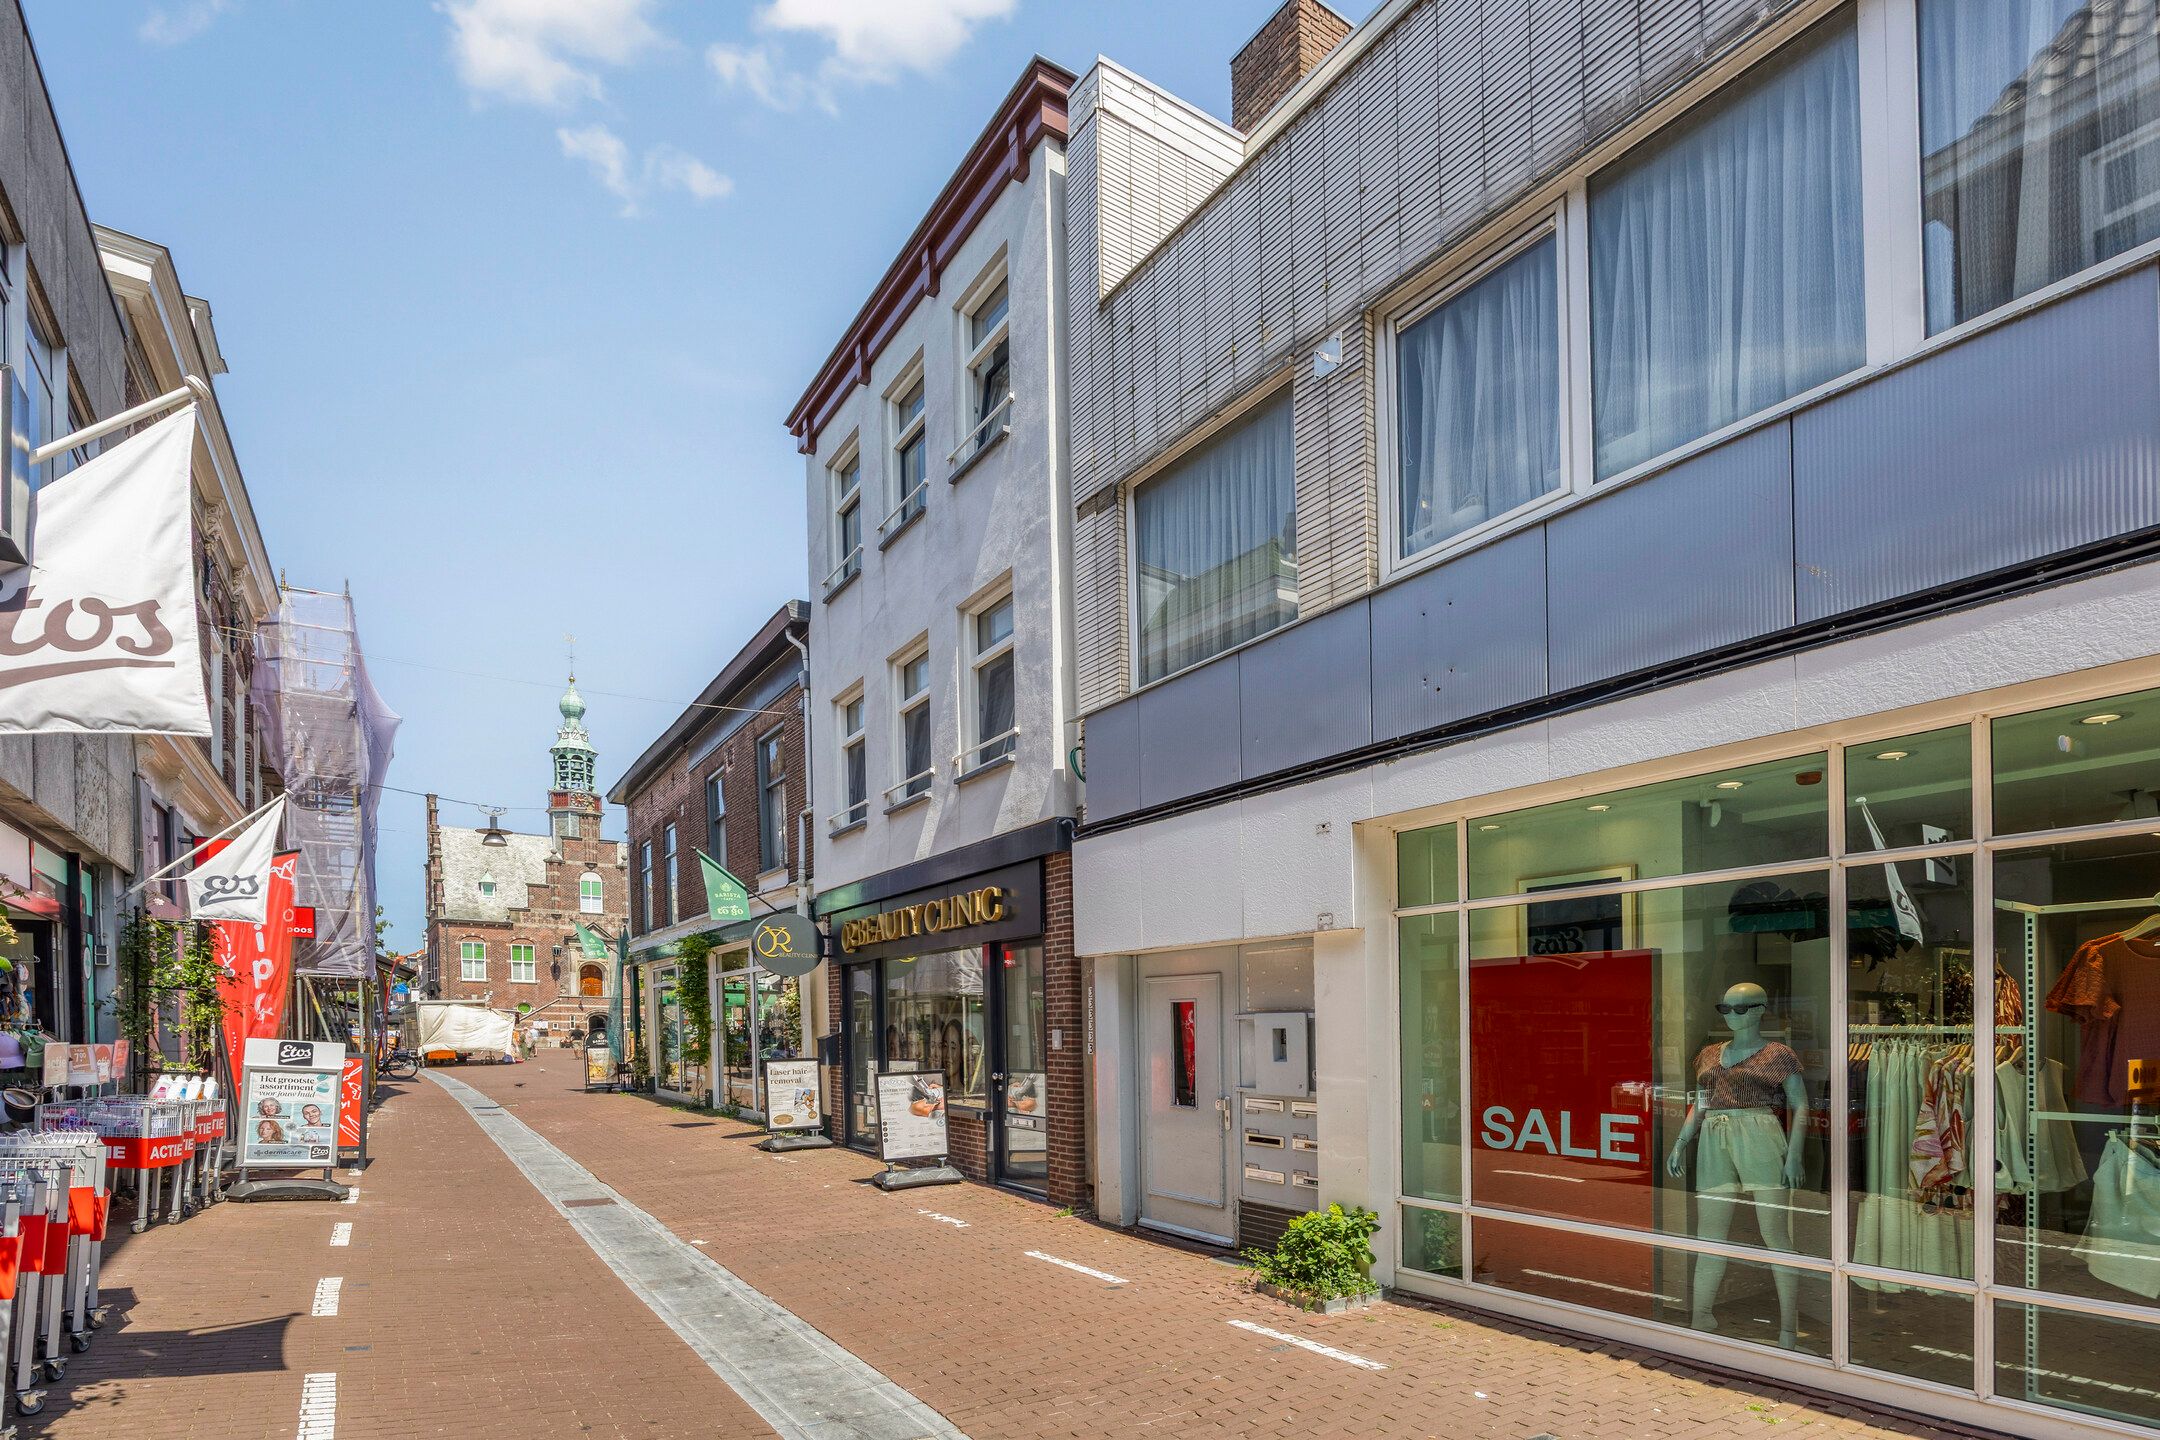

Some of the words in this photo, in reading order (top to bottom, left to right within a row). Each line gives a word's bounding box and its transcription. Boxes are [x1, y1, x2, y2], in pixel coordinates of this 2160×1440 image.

[0, 584, 173, 657] tos
[716, 907, 729, 915] to
[730, 907, 744, 917] go
[858, 903, 926, 946] BEAUTY
[924, 886, 1003, 933] CLINIC
[280, 1044, 312, 1058] Etos
[260, 1075, 277, 1083] Het
[277, 1076, 315, 1085] grootste
[259, 1084, 314, 1092] assortiment
[1481, 1105, 1640, 1163] SALE
[149, 1144, 183, 1160] ACTIE
[311, 1147, 329, 1156] Etos
